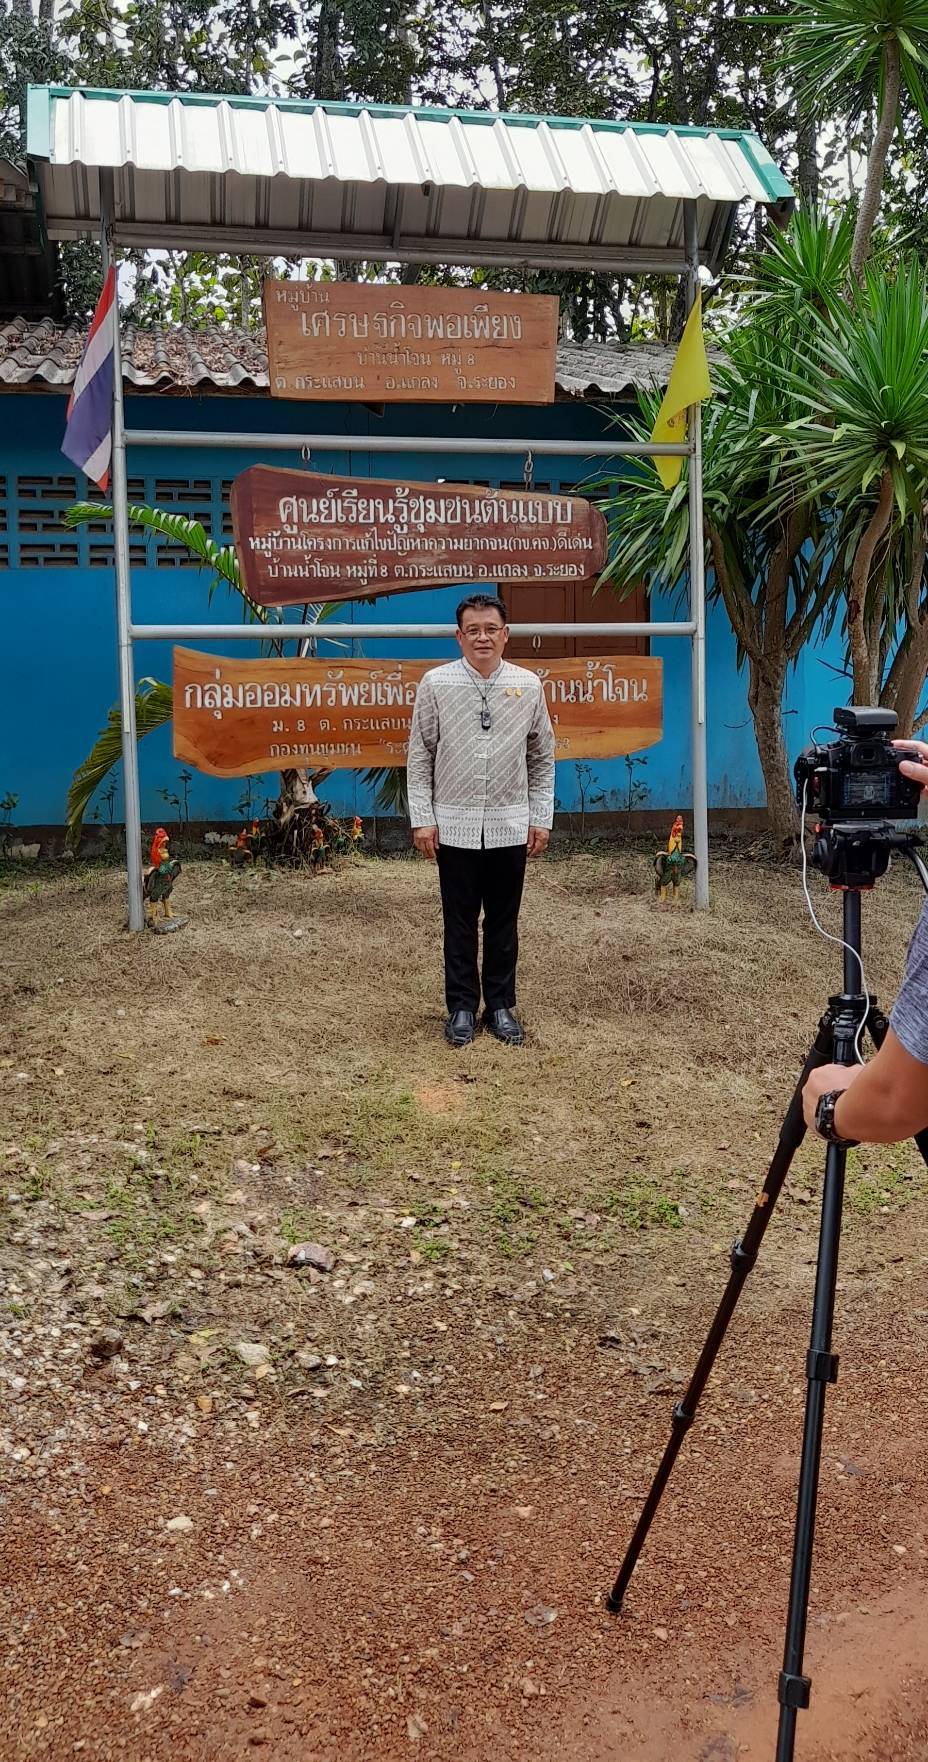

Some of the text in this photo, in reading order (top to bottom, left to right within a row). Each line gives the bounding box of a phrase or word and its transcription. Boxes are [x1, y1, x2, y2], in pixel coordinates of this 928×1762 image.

[275, 284, 330, 311] หมู่บ้าน
[279, 487, 574, 534] ศูนย์เรียนรู้ชุมชนต้นแบบ
[268, 554, 341, 578] บ้านน้ำโจน
[479, 564, 528, 578] อ.แกลง
[534, 563, 585, 577] จ.ระยอง
